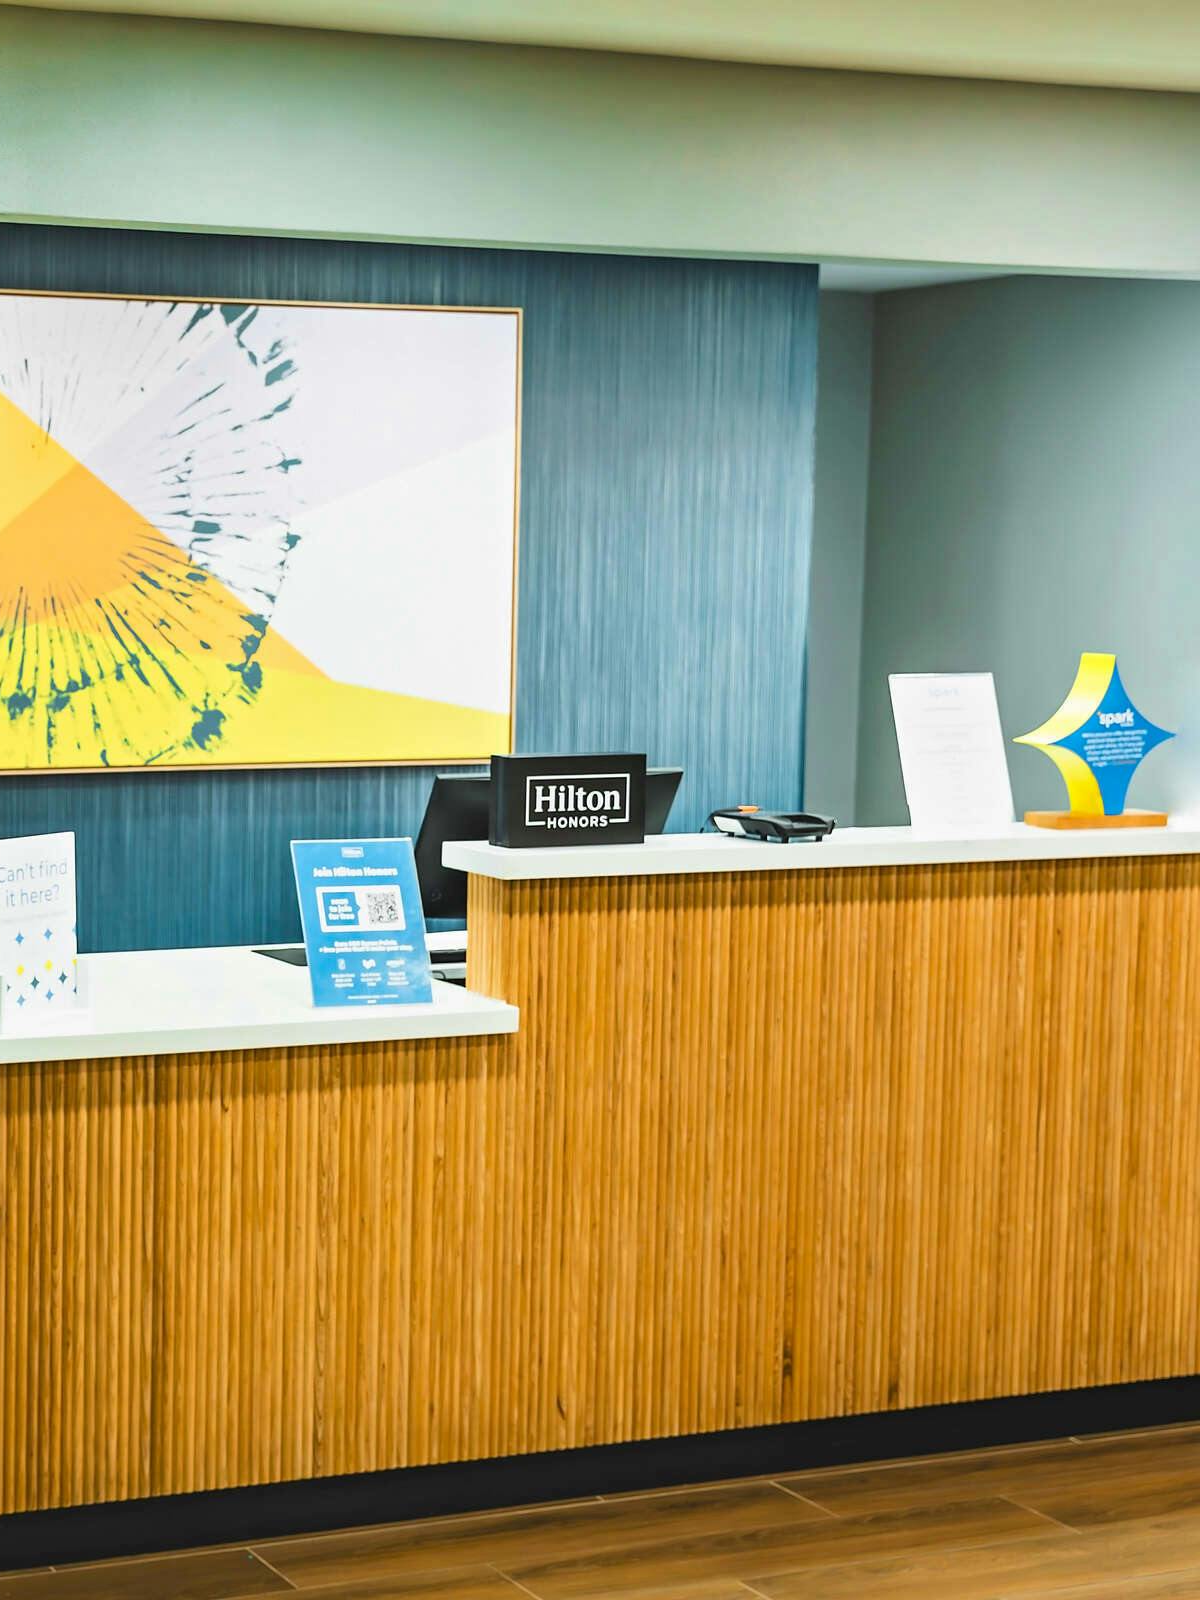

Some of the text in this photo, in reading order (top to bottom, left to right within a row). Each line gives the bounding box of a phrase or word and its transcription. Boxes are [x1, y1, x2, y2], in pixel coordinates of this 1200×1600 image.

[1099, 708, 1134, 728] spark
[534, 784, 621, 813] Hilton
[547, 815, 609, 829] HONORS
[38, 858, 68, 877] find
[5, 884, 61, 907] it here?
